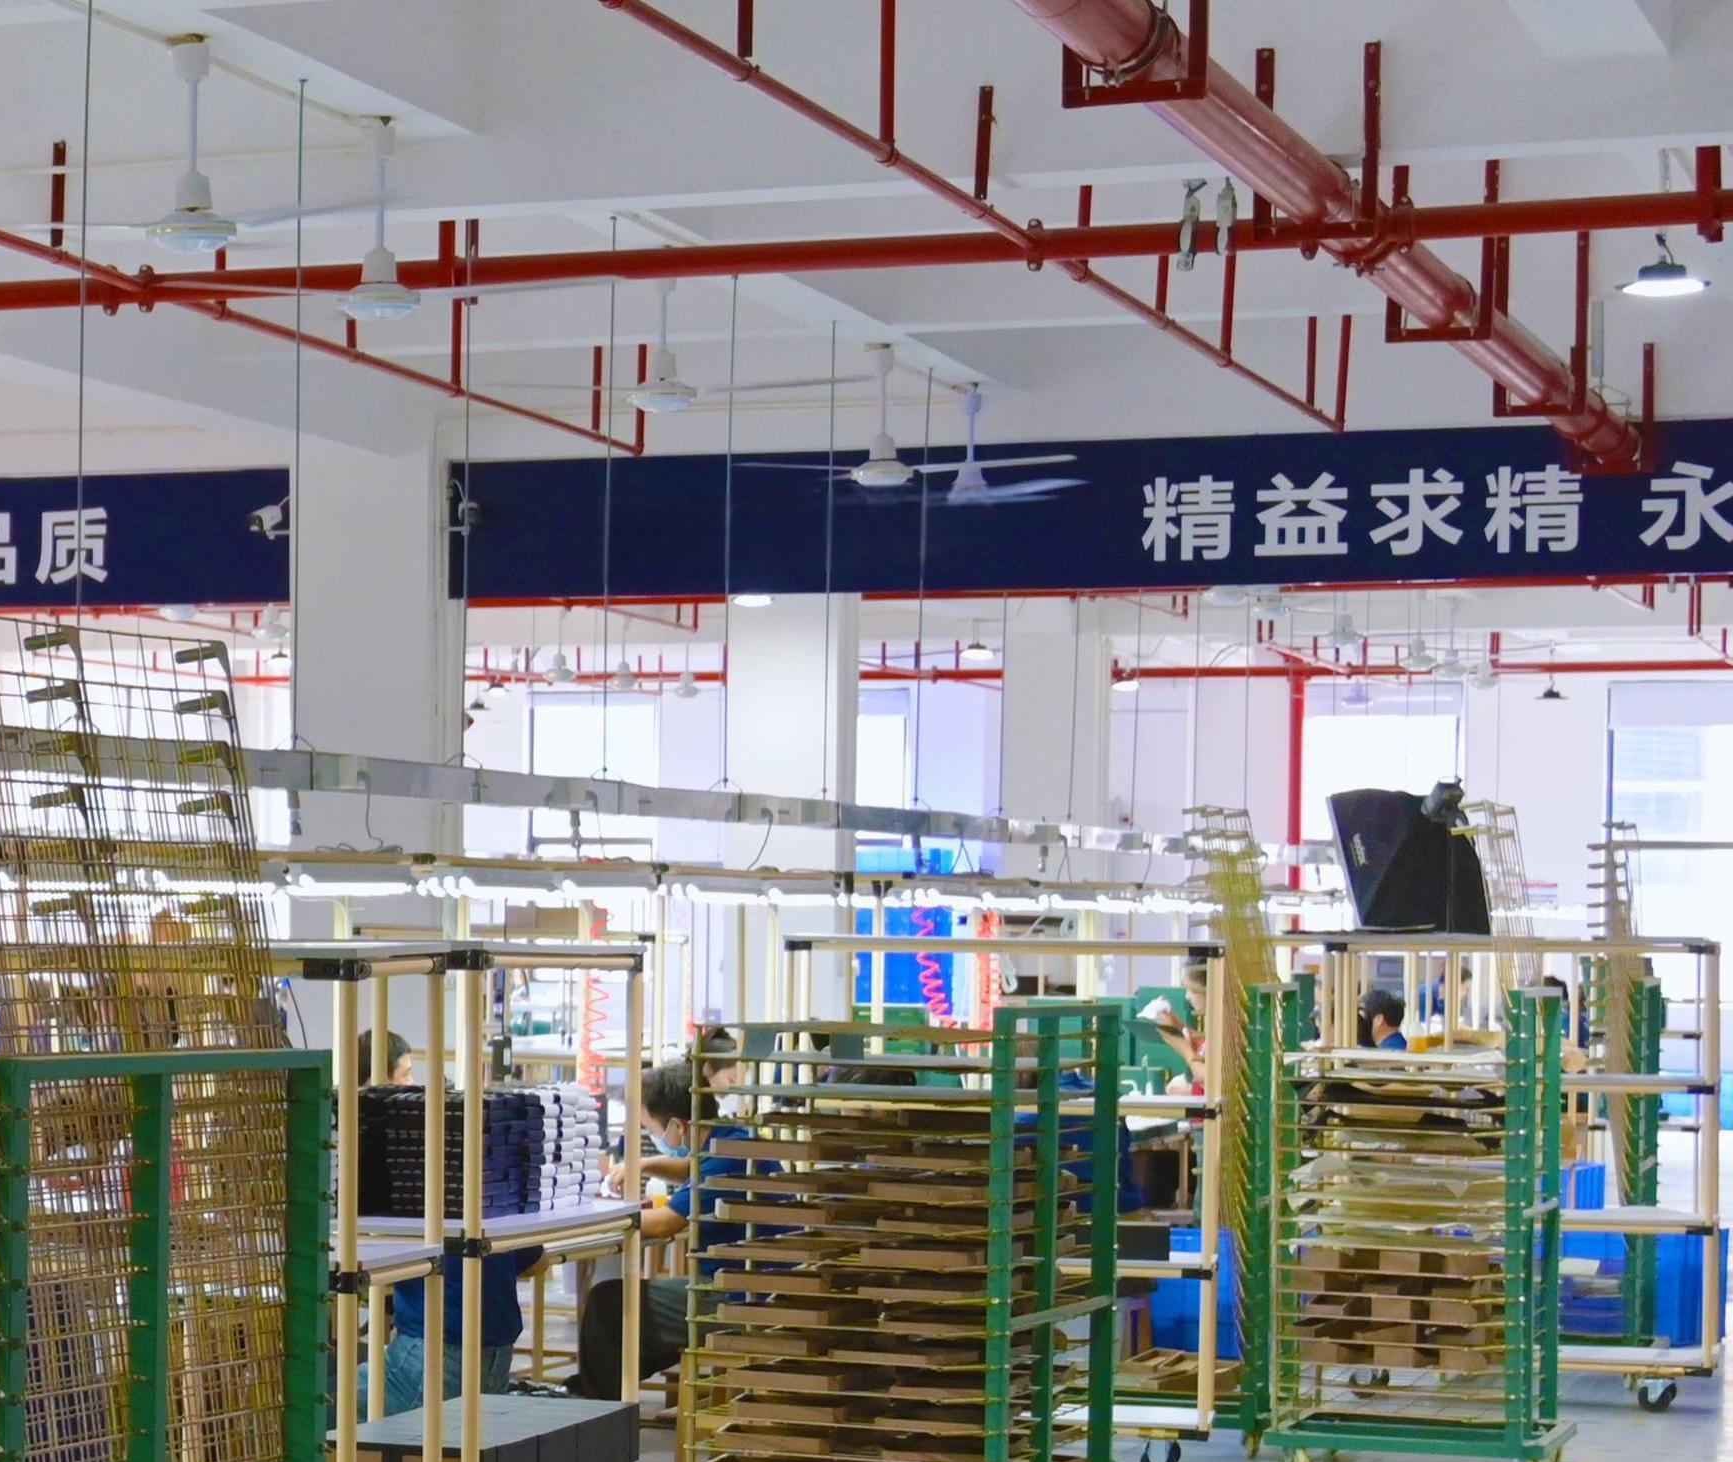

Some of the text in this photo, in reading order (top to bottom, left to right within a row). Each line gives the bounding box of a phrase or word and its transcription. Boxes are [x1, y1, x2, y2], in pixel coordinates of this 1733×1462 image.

[1141, 461, 1733, 562] 精益求精 永
